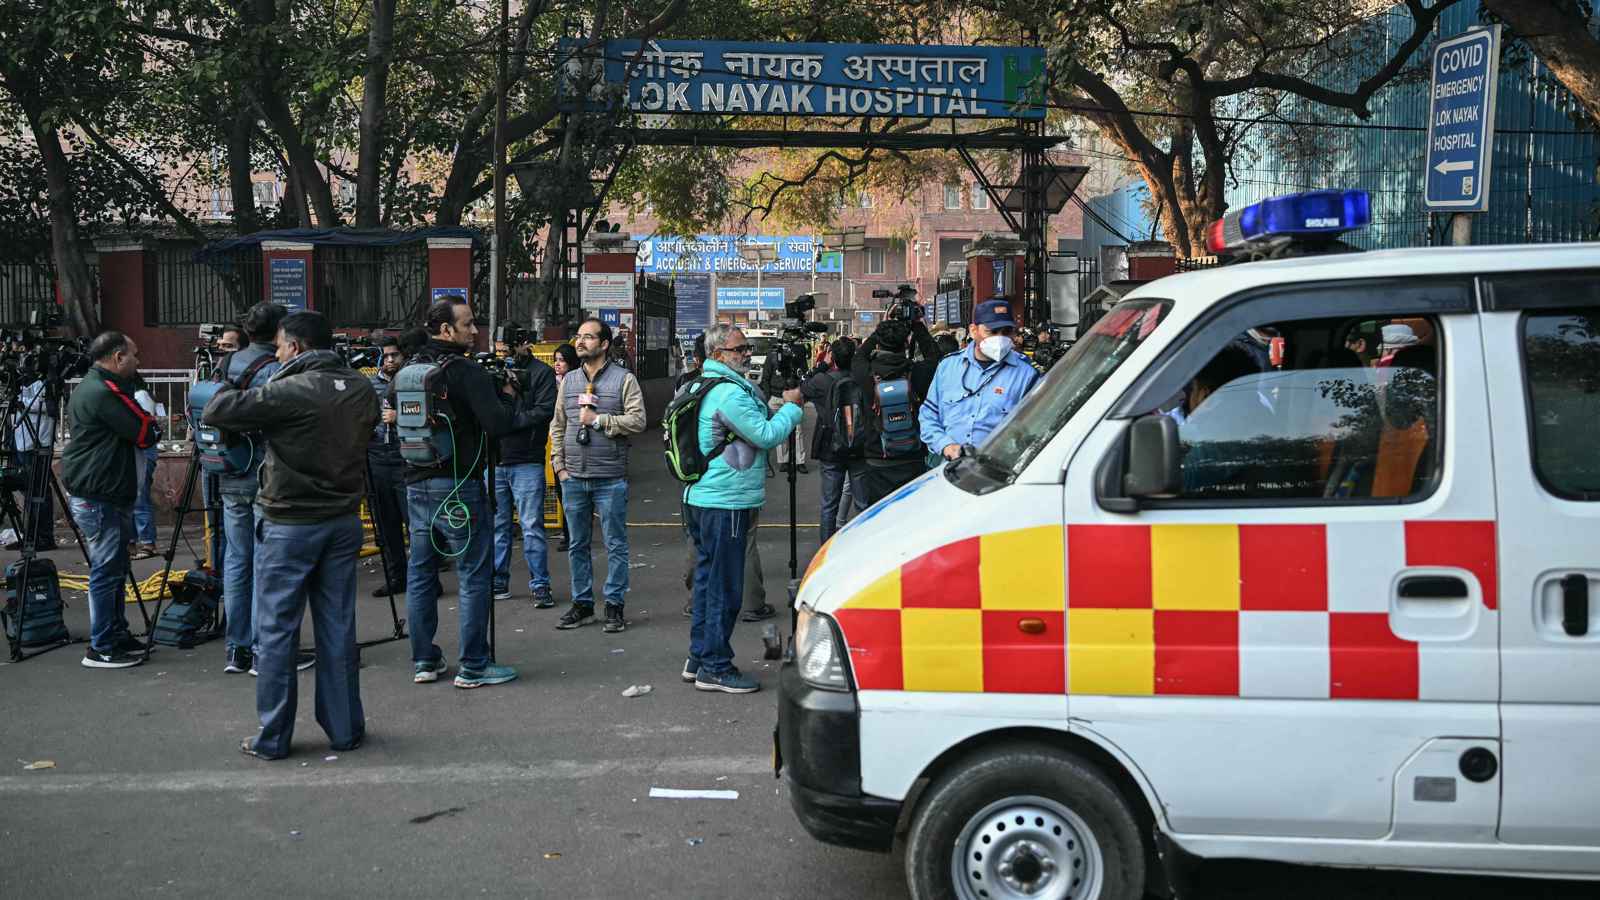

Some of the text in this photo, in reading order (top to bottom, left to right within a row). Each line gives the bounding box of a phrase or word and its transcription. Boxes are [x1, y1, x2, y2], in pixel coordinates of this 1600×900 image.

[722, 52, 824, 80] नायक
[842, 54, 988, 84] अस्पताल
[1440, 43, 1483, 74] COVID
[624, 82, 987, 115] LOK NAYAK HOSPITAL
[1435, 74, 1484, 99] EMERGENCY
[1435, 105, 1479, 127] LOK NAYAK
[1434, 132, 1477, 152] HOSPITAL
[704, 257, 711, 270] &
